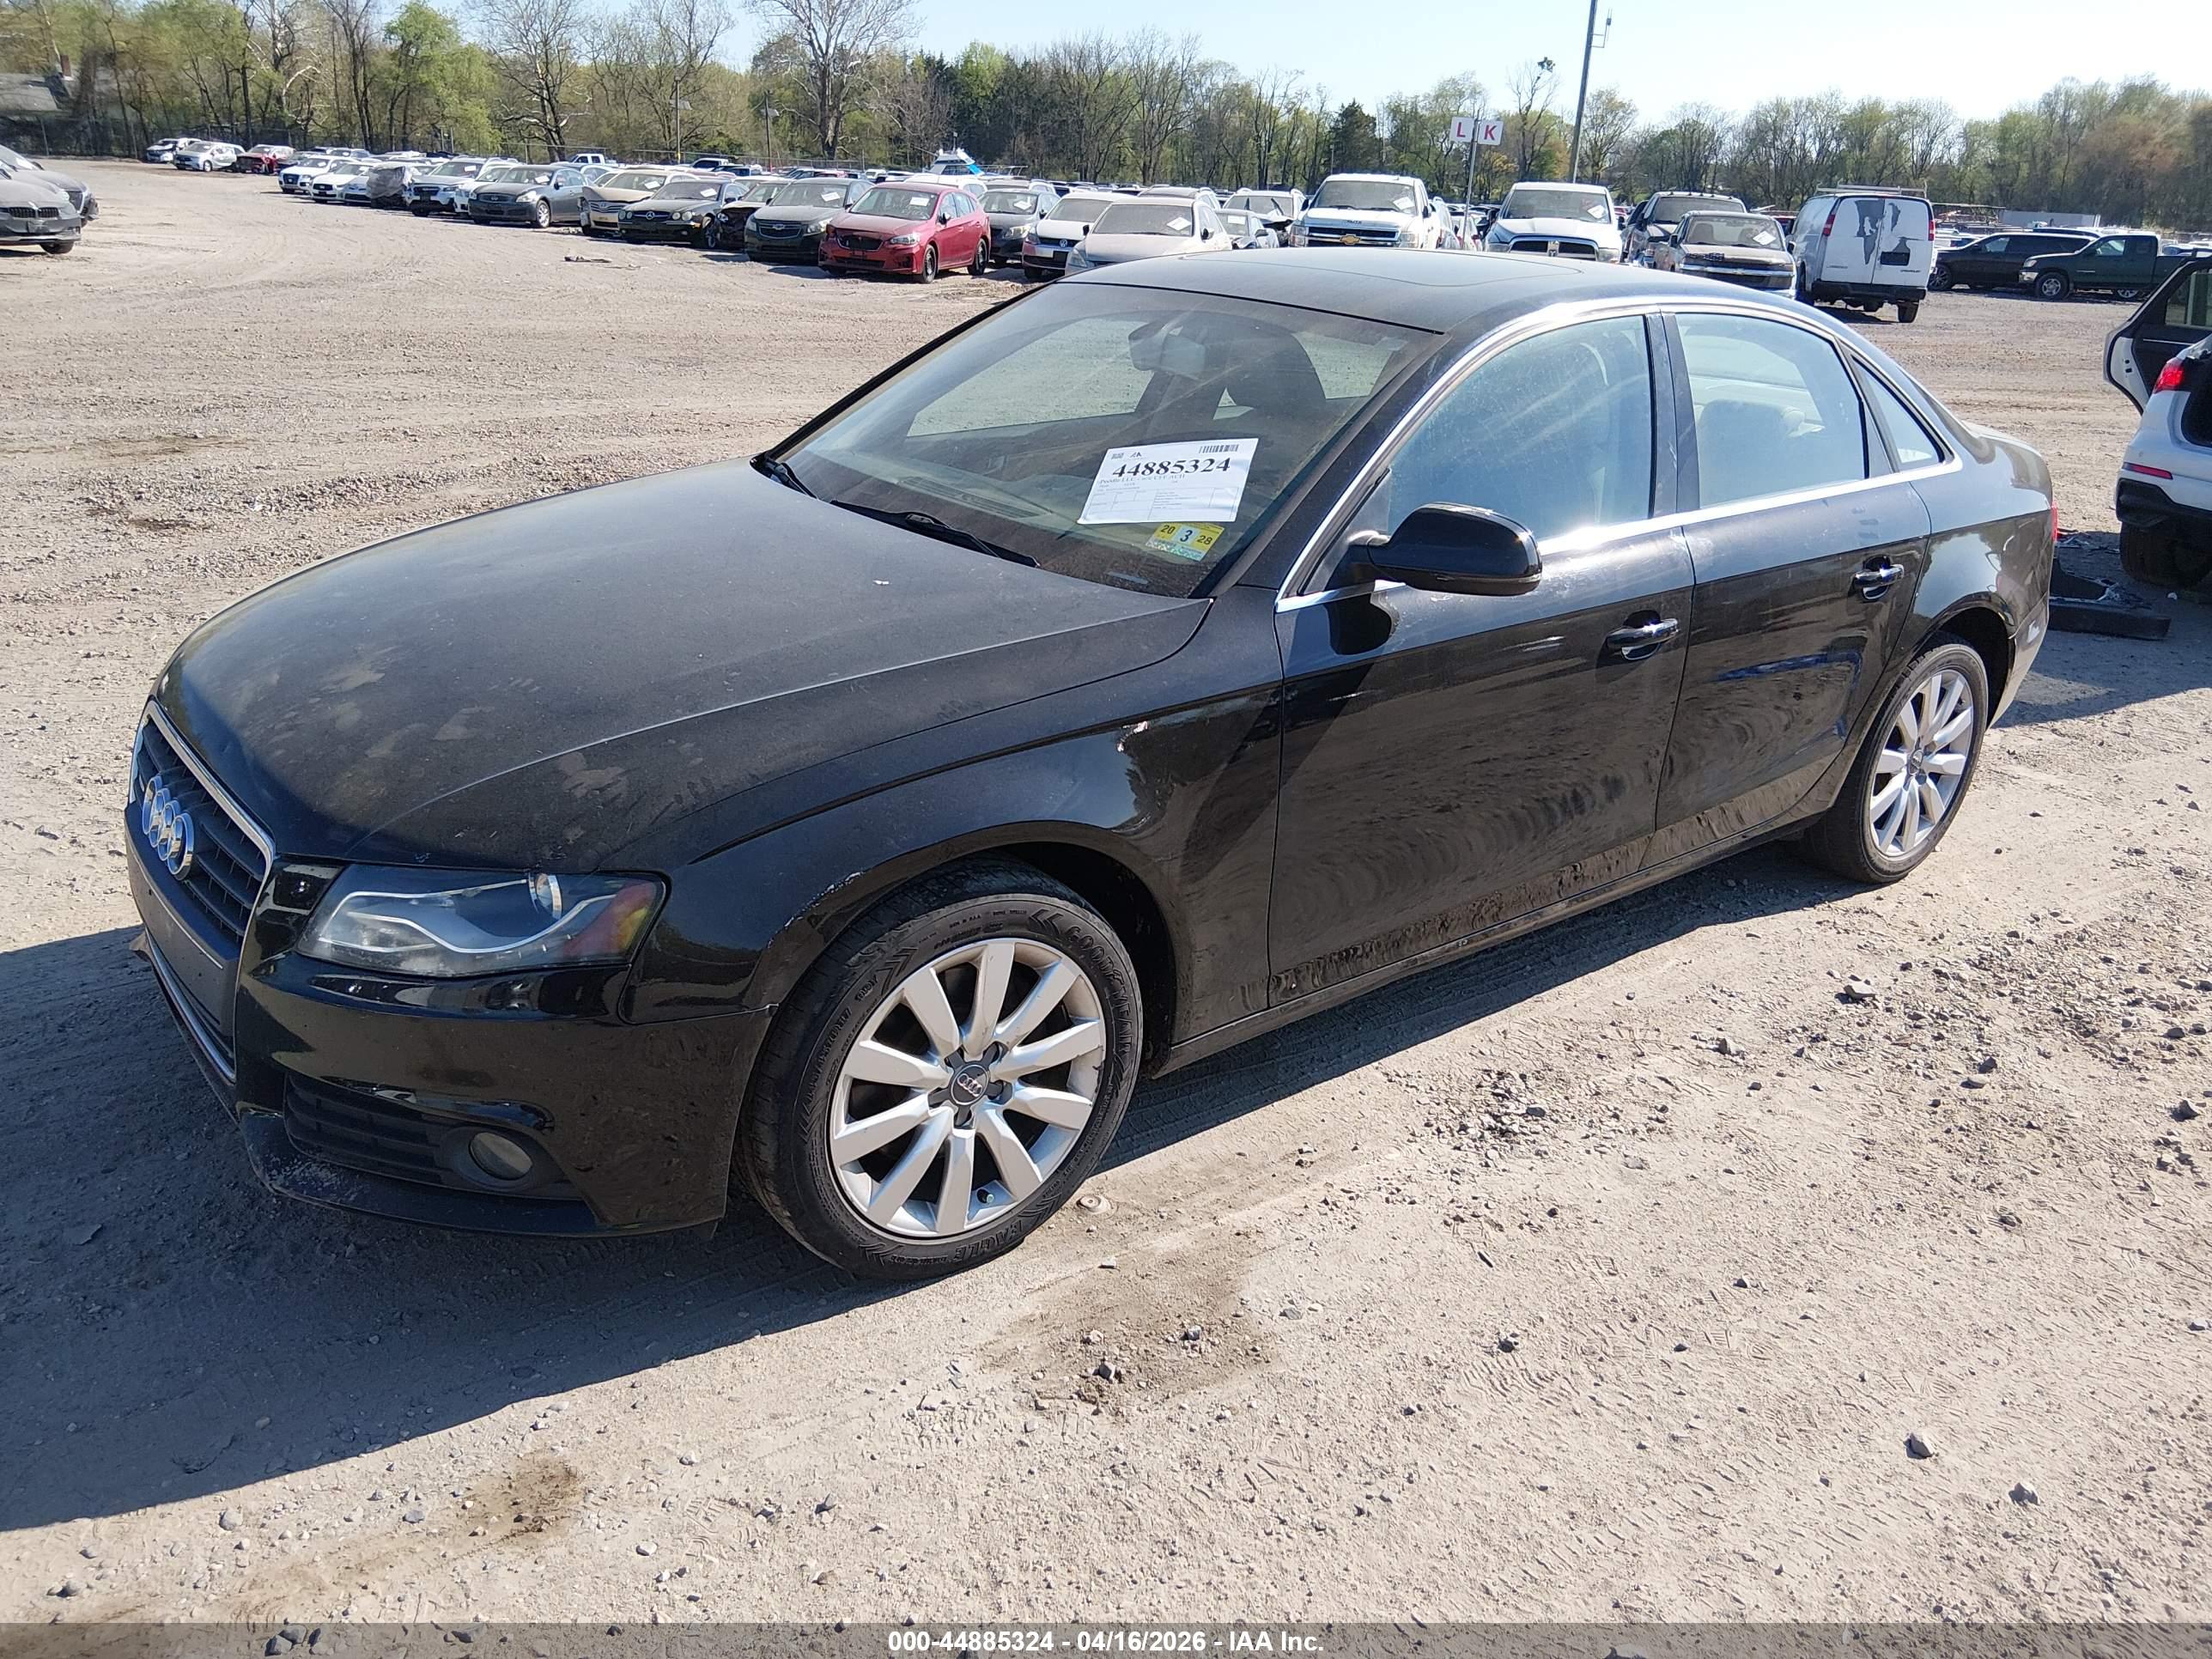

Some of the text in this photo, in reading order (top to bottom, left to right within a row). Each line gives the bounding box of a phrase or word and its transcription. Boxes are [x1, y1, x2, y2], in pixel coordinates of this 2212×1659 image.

[1456, 122, 1466, 137] L
[1484, 125, 1497, 140] K
[1112, 458, 1231, 477] 44885324
[1161, 525, 1212, 545] 20 3 28
